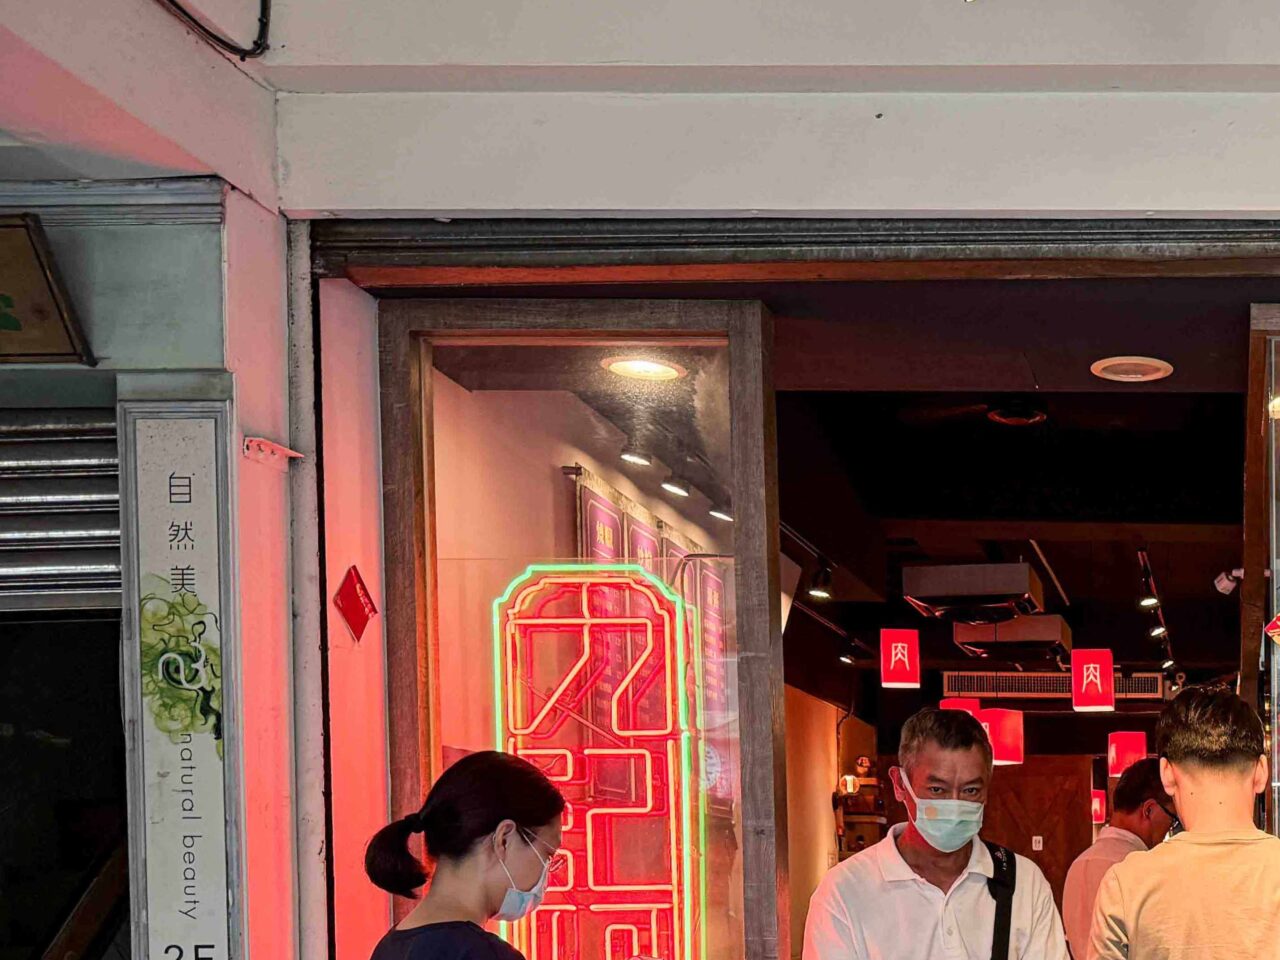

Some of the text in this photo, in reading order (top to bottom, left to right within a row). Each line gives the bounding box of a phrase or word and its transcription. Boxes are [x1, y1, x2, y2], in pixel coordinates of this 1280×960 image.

[167, 471, 196, 594] 自然美
[179, 733, 203, 921] natural beauty
